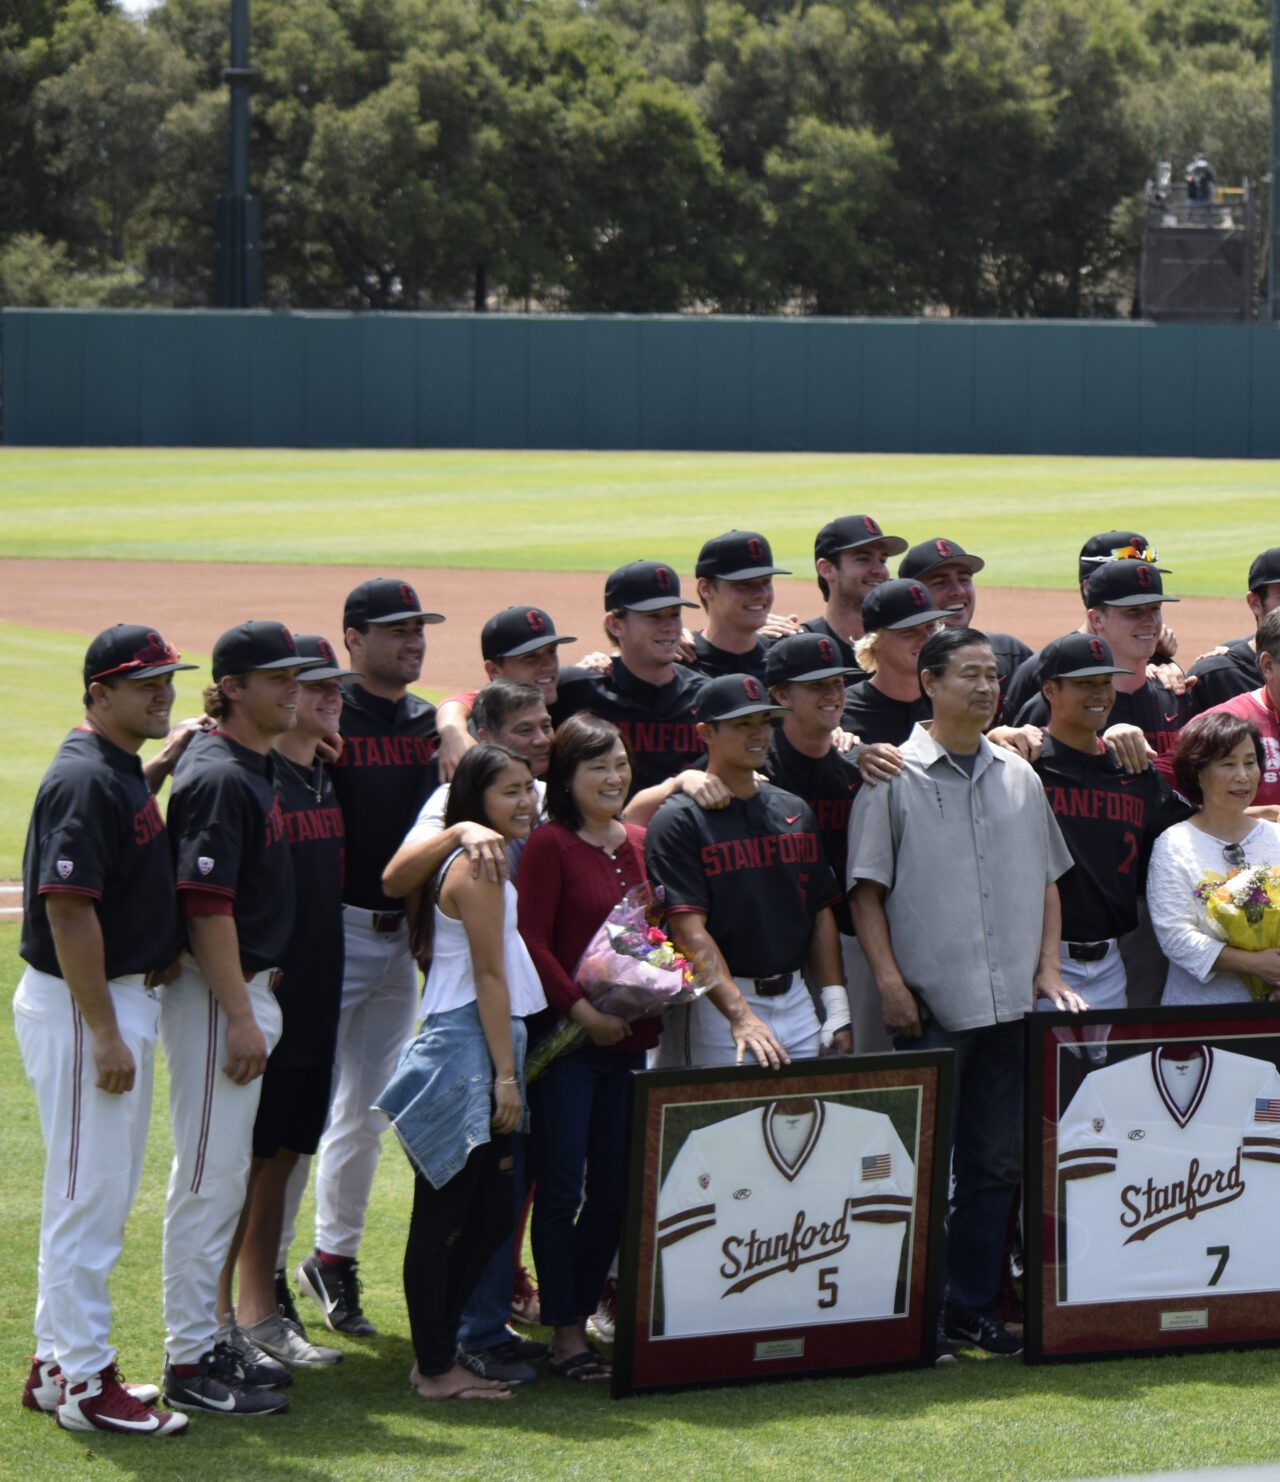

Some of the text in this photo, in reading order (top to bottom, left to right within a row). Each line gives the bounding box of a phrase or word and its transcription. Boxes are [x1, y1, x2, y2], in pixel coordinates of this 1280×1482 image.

[700, 832, 818, 877] STANFORD
[1118, 832, 1137, 875] 2
[1120, 1144, 1245, 1246] Stanford
[720, 1198, 851, 1298] Stanford
[1206, 1245, 1230, 1286] 7
[817, 1266, 839, 1308] 5
